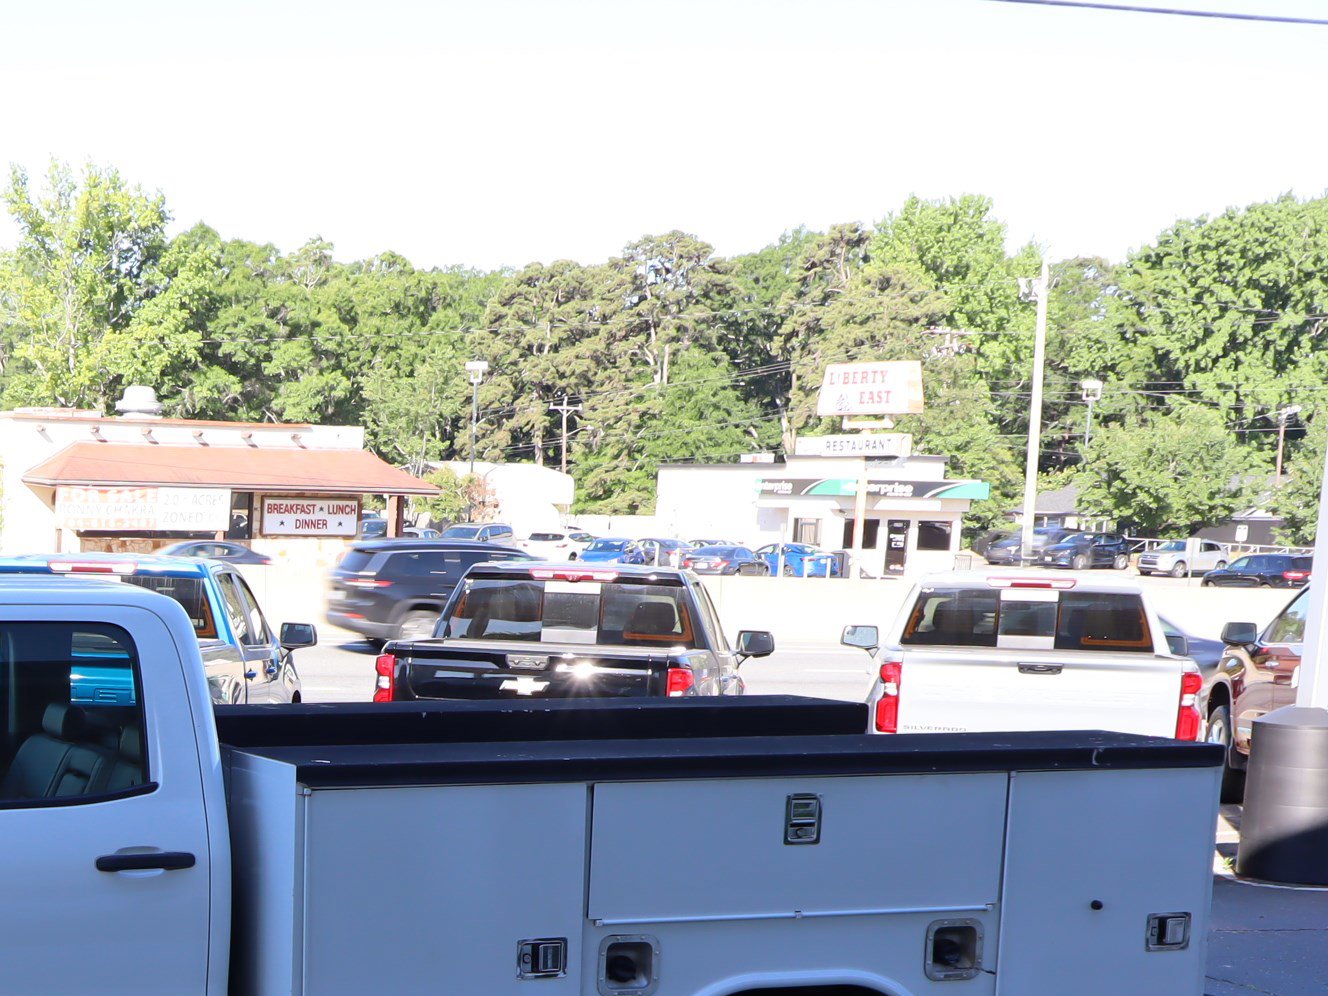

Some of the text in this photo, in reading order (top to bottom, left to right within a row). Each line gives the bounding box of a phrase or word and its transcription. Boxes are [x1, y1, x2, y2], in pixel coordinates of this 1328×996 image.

[828, 369, 889, 386] LIBERTY
[858, 390, 893, 405] EAST
[825, 438, 892, 451] RESTAURANT
[266, 503, 357, 516] BREAKFAST LUNCH
[162, 511, 204, 524] ZONED
[294, 518, 328, 530] DINNER
